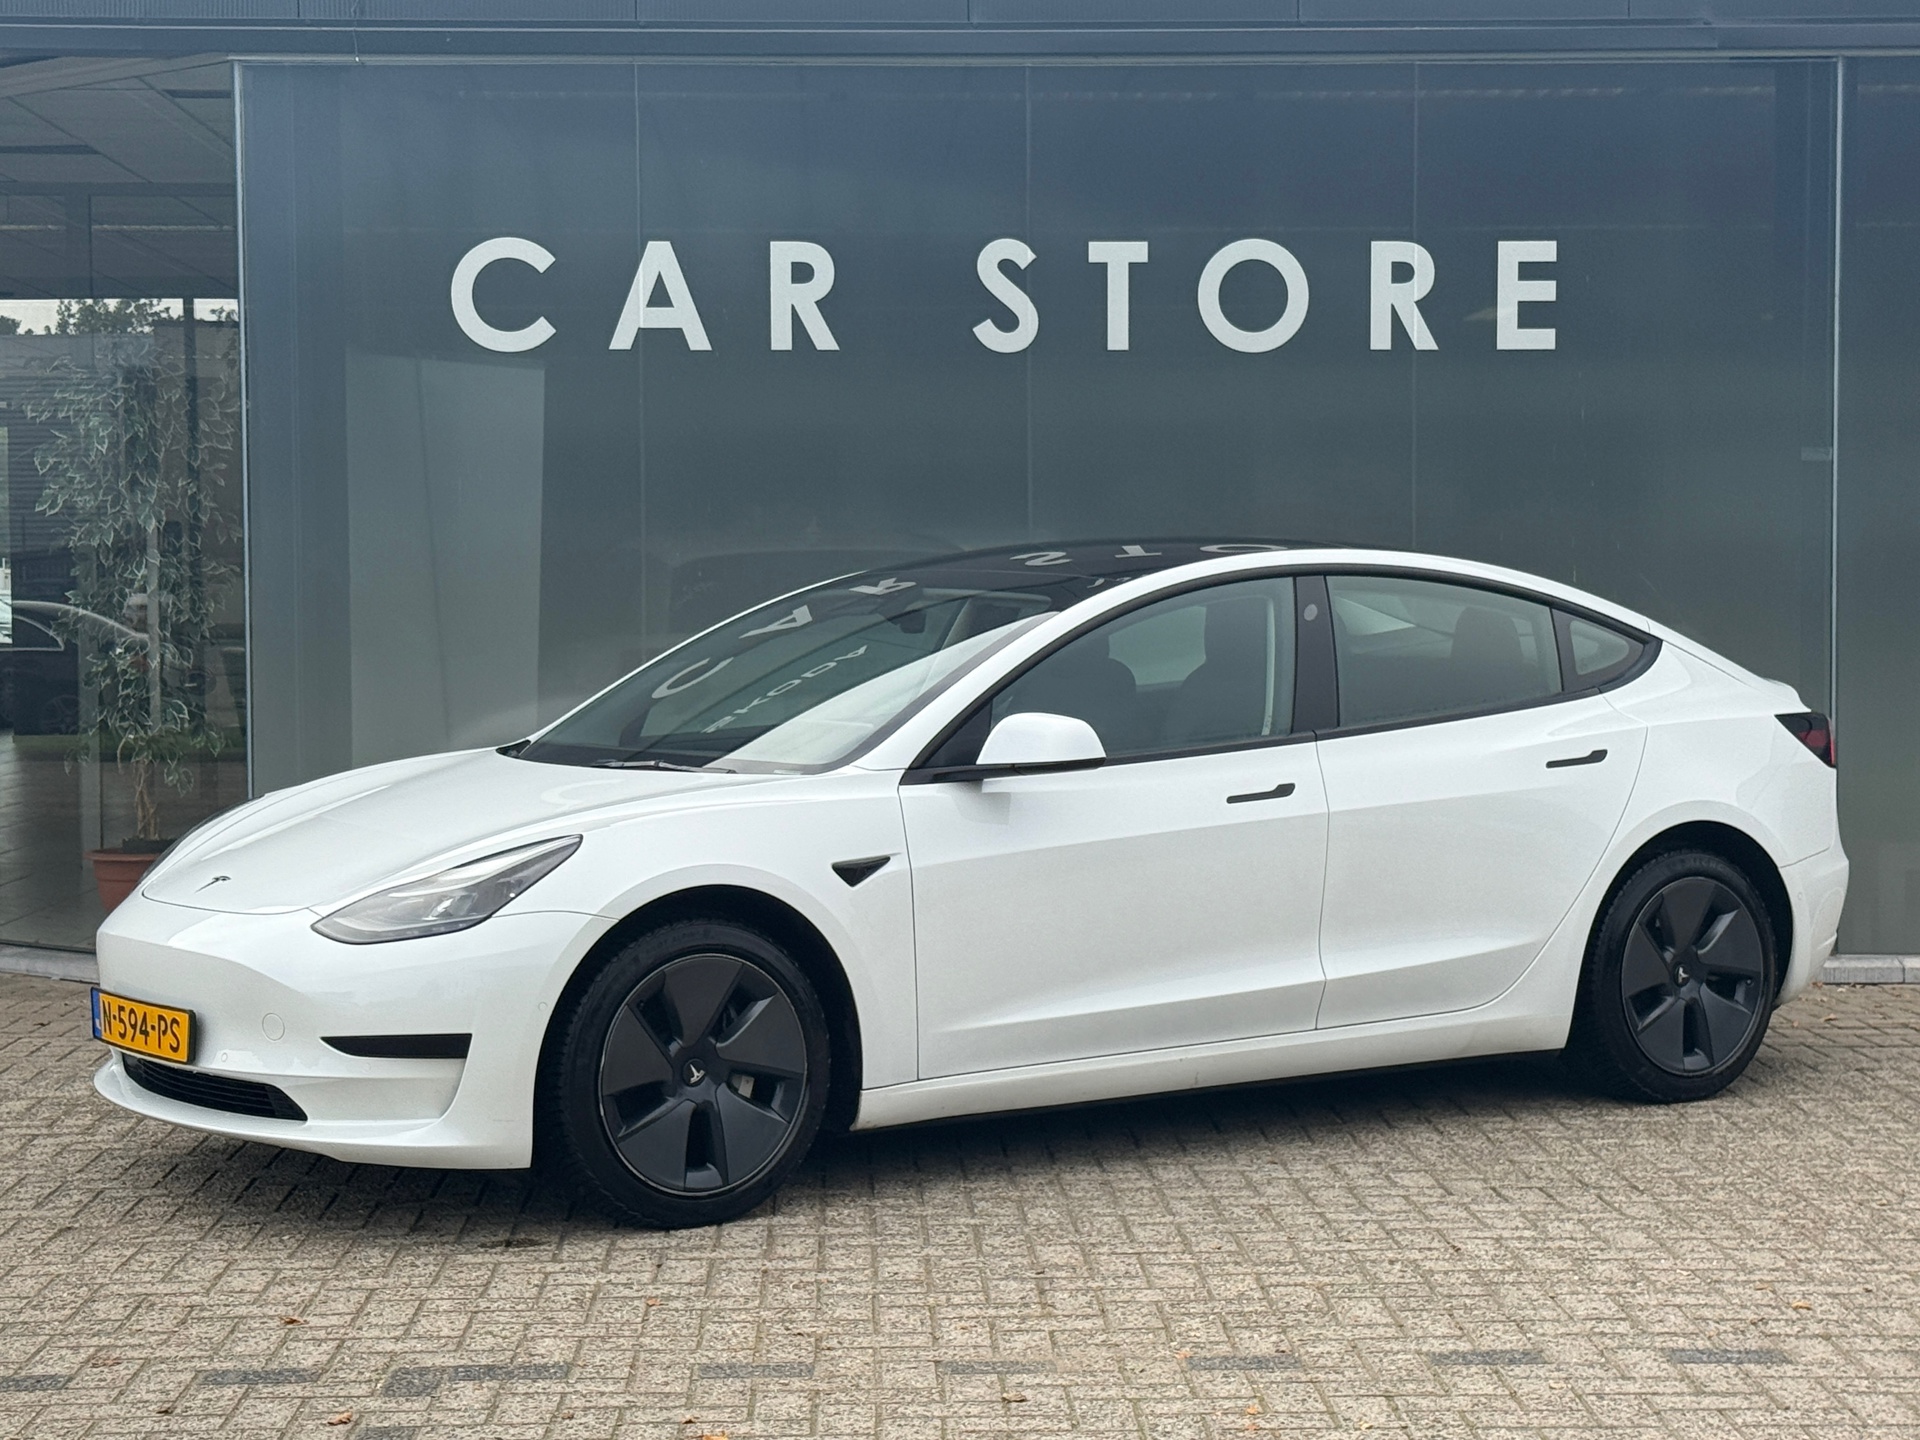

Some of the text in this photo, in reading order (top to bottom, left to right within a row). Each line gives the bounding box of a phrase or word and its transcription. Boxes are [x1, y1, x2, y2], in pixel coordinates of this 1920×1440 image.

[450, 236, 1558, 353] CAR STORE
[101, 999, 181, 1054] N-594-PS
